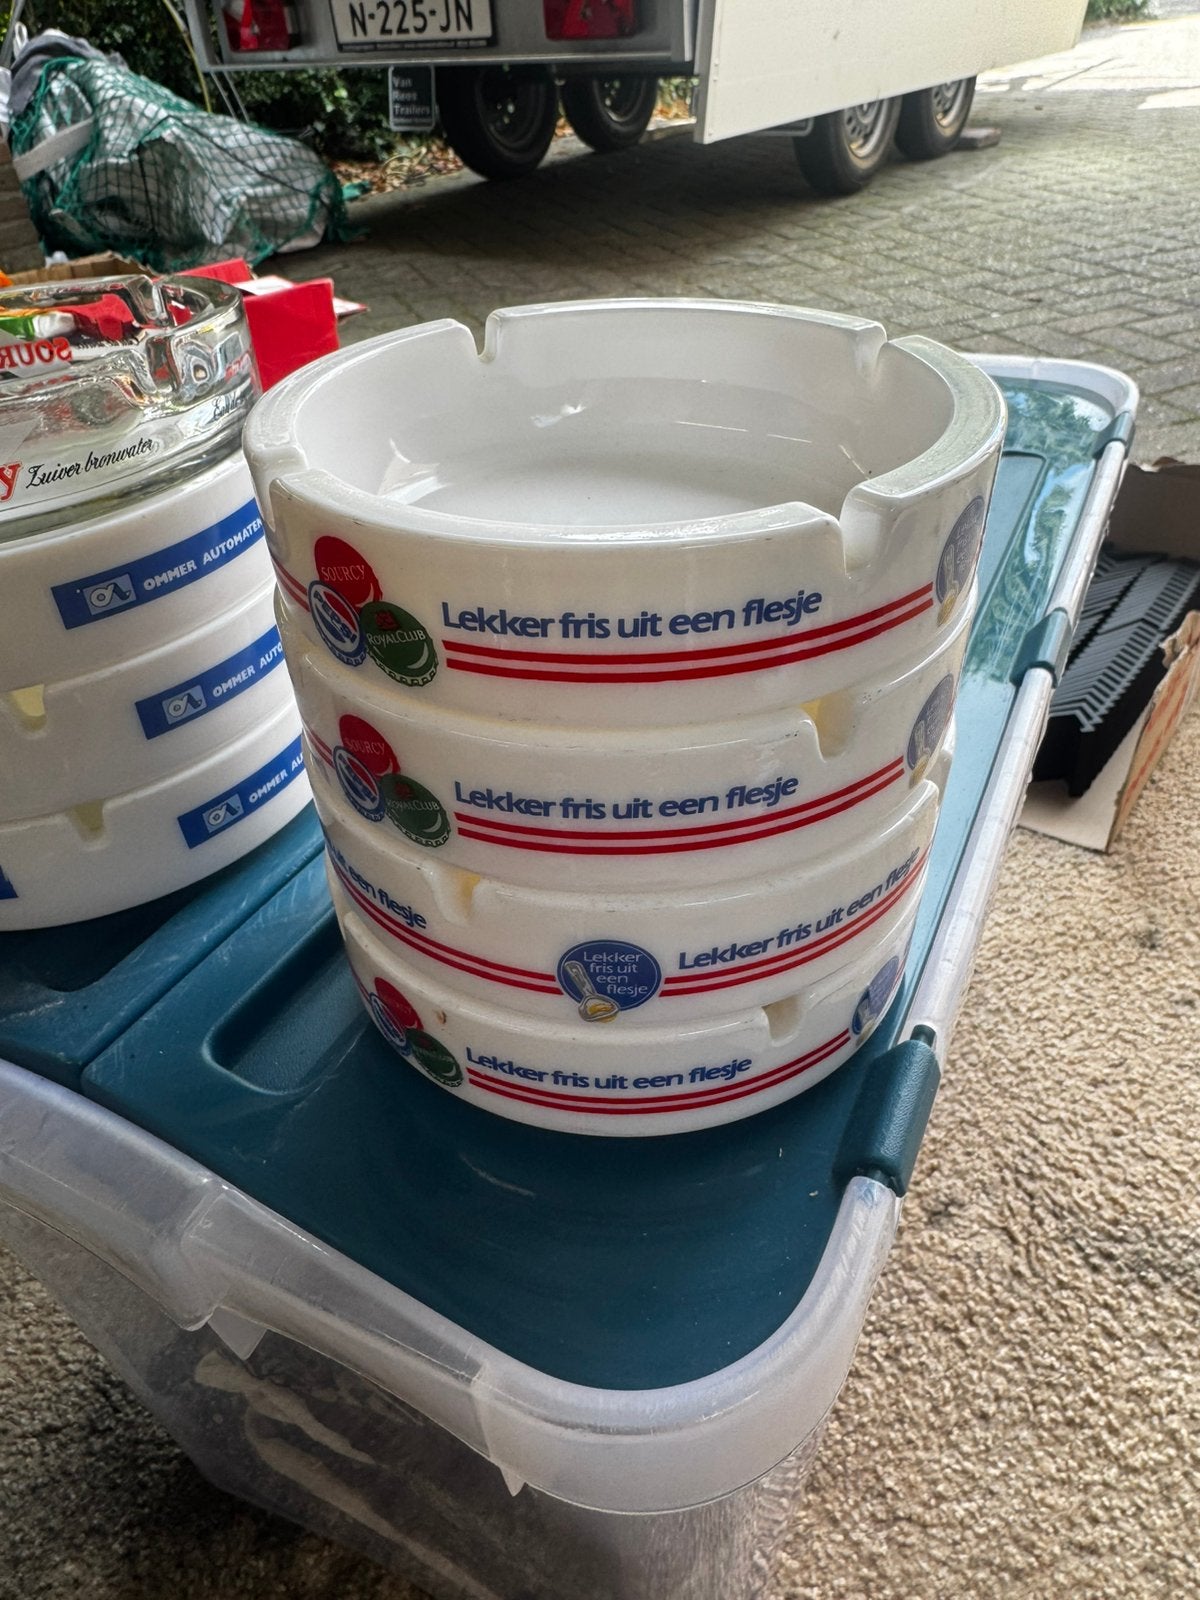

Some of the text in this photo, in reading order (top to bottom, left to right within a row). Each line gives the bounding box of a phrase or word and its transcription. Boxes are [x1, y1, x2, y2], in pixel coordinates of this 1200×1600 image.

[350, 0, 473, 37] N-225-JN
[26, 464, 83, 489] Zuiver
[85, 438, 152, 472] bronwater
[143, 559, 198, 591] OMMER
[321, 565, 365, 581] SOURCY
[442, 590, 822, 639] Lekker fris uit een flesje
[212, 664, 256, 698] OMMER
[248, 768, 288, 803] OMMER
[455, 776, 799, 820] Lekker fris uit een flesje
[378, 888, 427, 929] flesje
[679, 937, 775, 970] Lekker
[776, 924, 812, 948] fris
[815, 907, 845, 933] uit
[846, 884, 883, 916] een
[583, 951, 642, 963] Lekker
[590, 963, 638, 973] fris uit
[596, 975, 628, 983] een
[607, 984, 648, 998] flesje
[466, 1046, 550, 1083] Lekker
[551, 1070, 590, 1088] fris
[594, 1073, 626, 1090] uit
[632, 1072, 684, 1089] een
[688, 1057, 752, 1084] flesje
